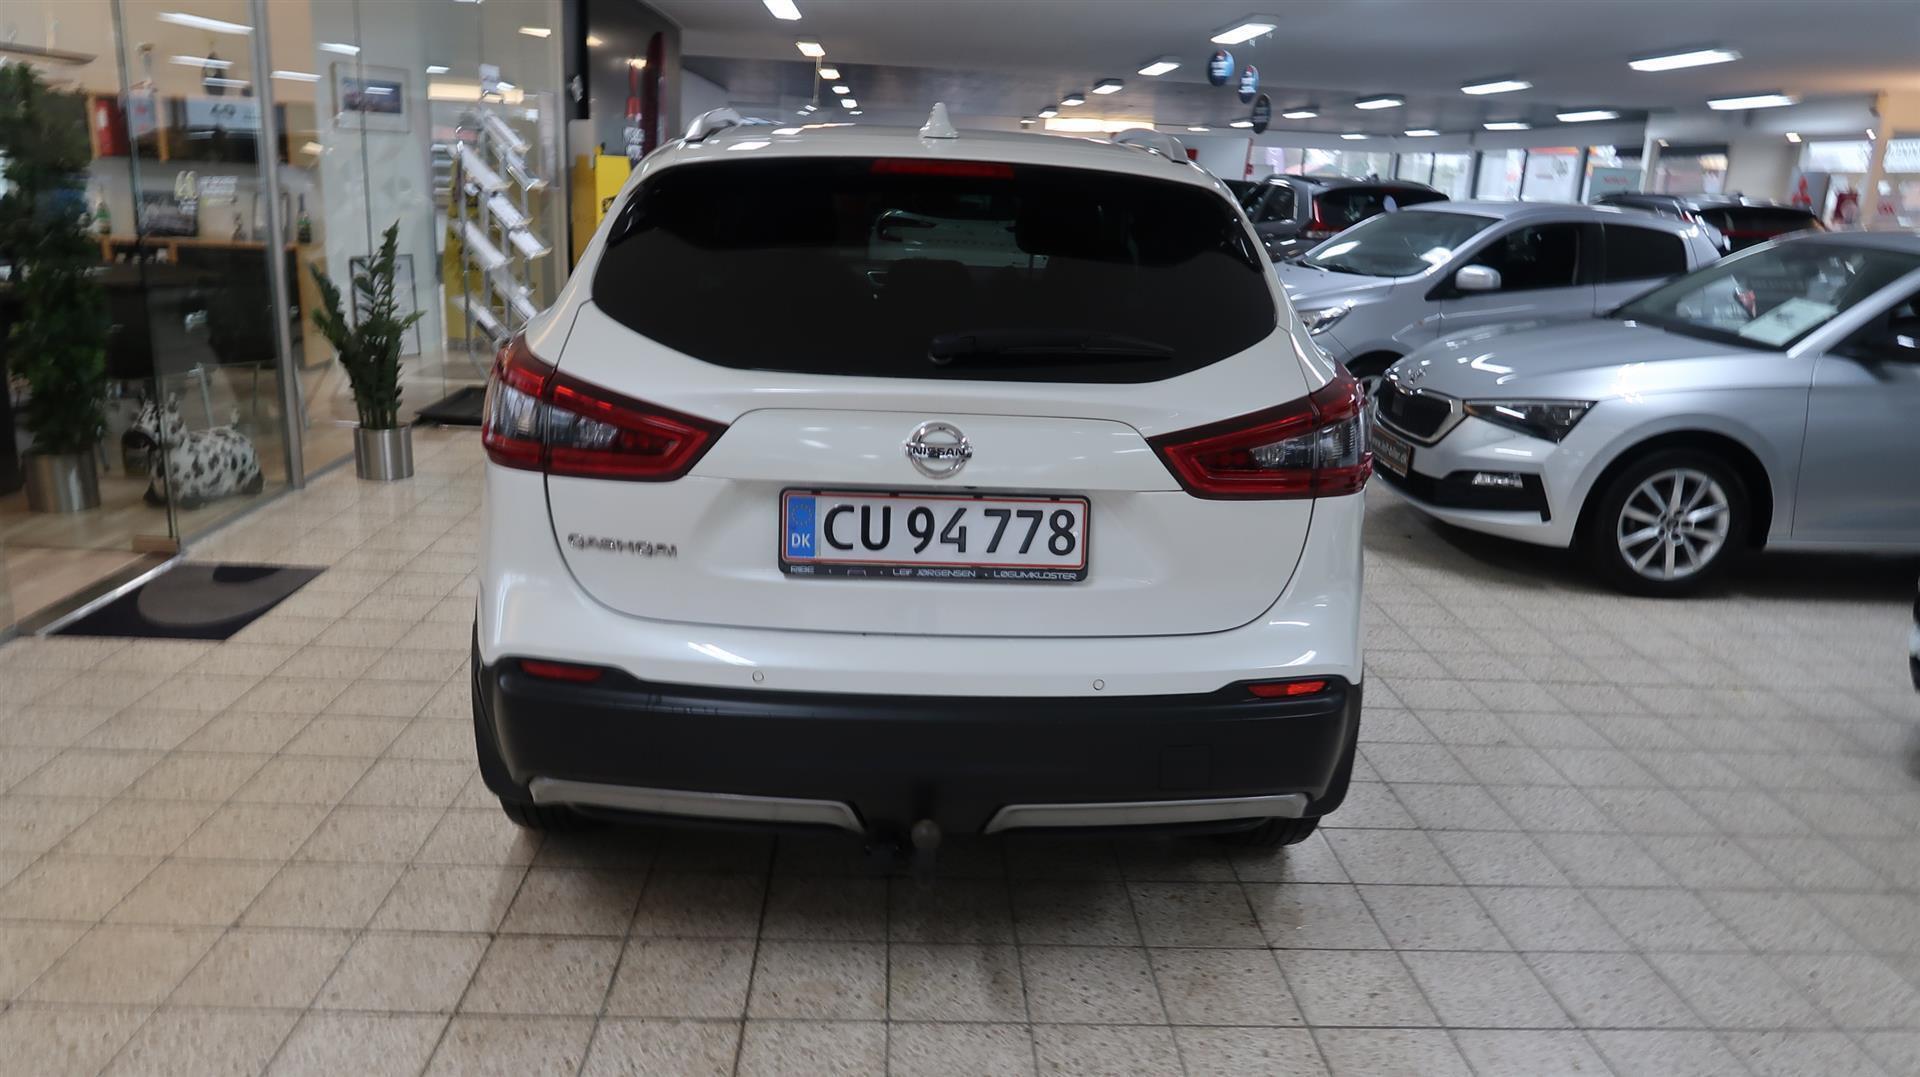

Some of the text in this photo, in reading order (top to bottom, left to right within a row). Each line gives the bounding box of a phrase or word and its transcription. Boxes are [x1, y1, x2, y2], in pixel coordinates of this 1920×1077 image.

[912, 446, 966, 458] NISSAN
[823, 504, 1076, 556] CU 94 778
[567, 533, 678, 557] QASHQAI
[791, 532, 811, 548] DK
[892, 567, 1077, 580] LEIF JØRGENSEN LØGUMKLOSTER
